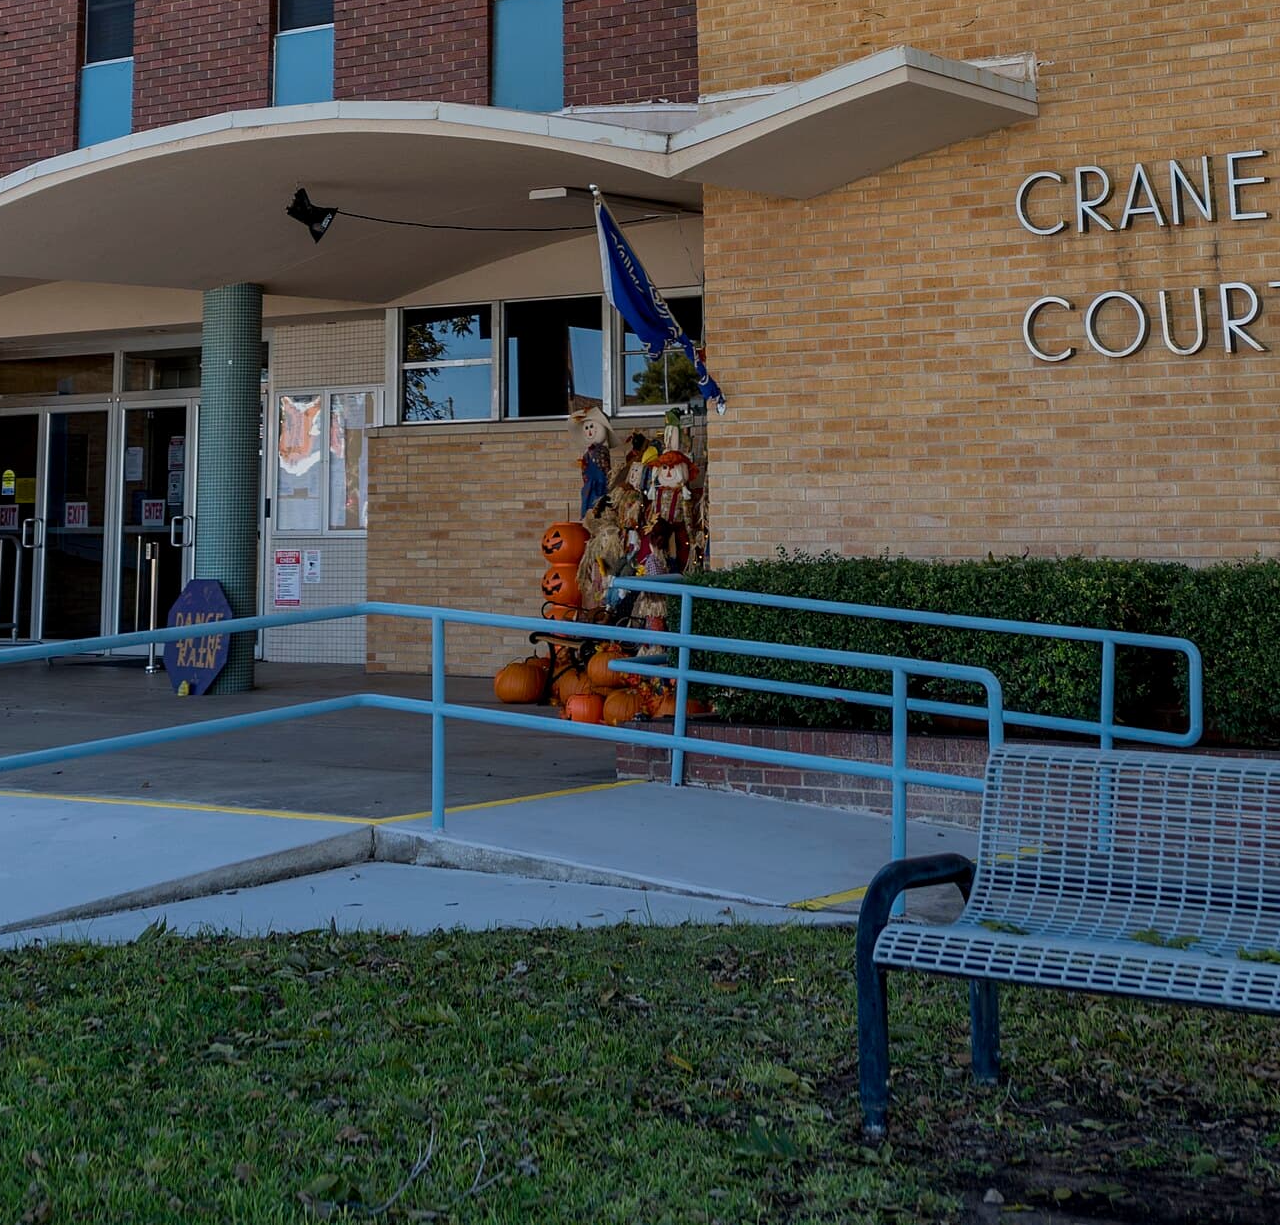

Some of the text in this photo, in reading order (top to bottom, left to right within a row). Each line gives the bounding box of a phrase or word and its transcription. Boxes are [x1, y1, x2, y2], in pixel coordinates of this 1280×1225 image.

[1015, 149, 1271, 235] CRANE
[0, 506, 17, 527] EXIT
[66, 505, 86, 524] EXIT
[144, 502, 163, 520] ENTER
[176, 647, 218, 669] RAIN
